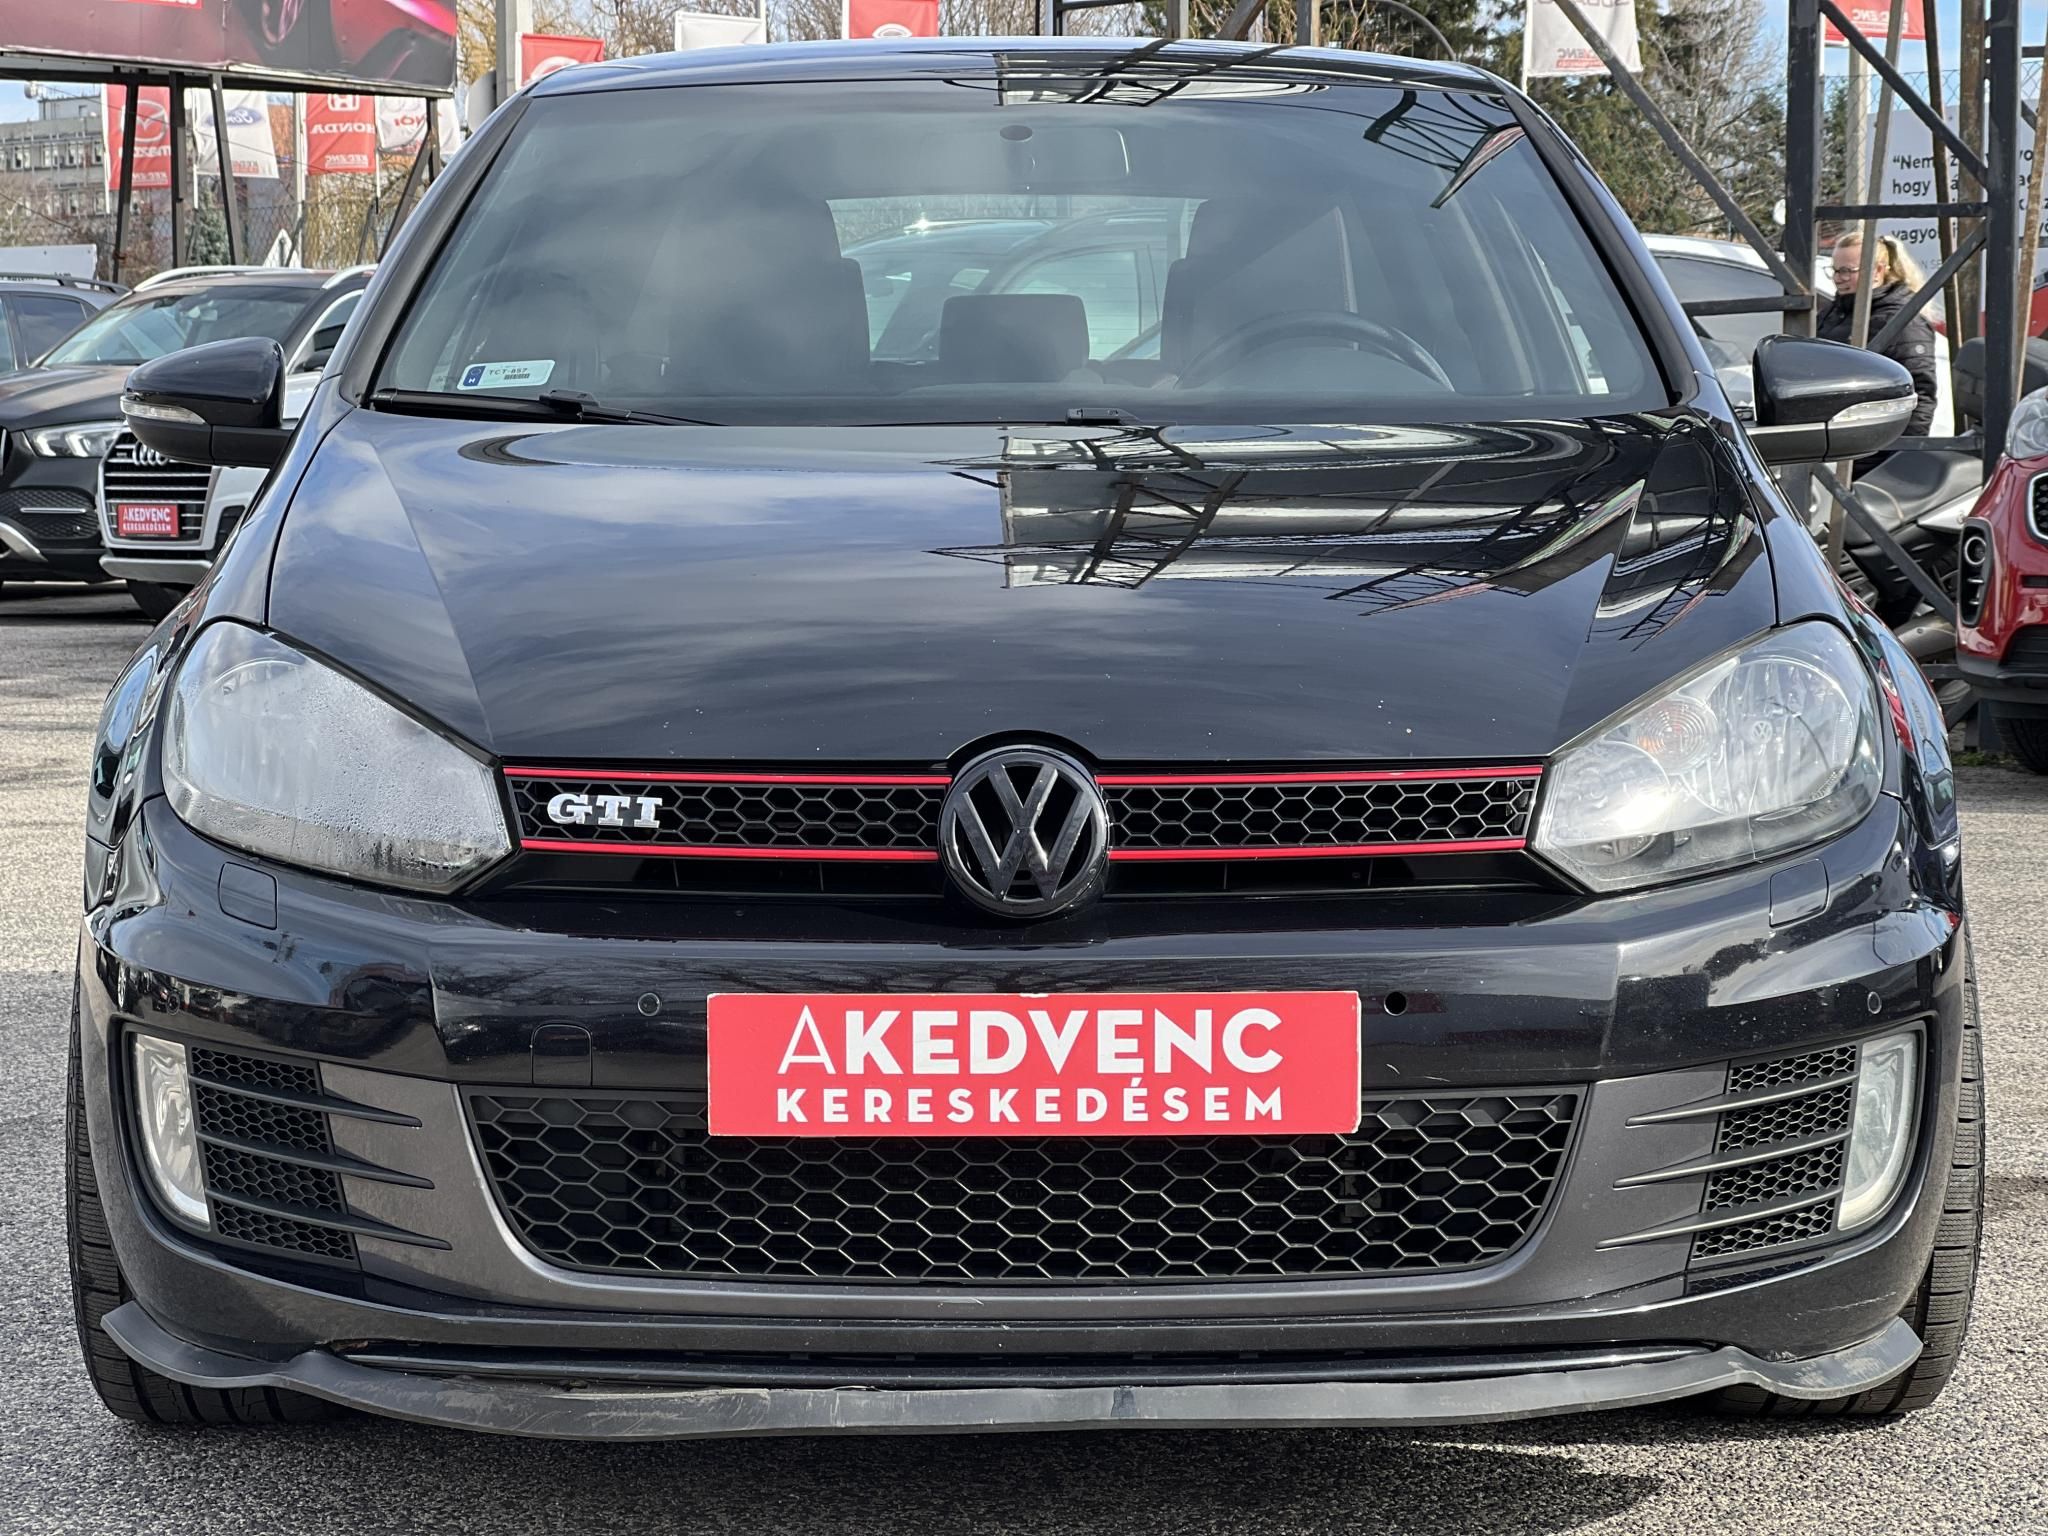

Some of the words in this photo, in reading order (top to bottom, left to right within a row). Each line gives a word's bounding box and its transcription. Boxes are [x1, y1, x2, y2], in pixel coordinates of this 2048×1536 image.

[1892, 179, 1931, 196] hogy
[1891, 227, 1937, 244] vagyo
[547, 792, 663, 829] GTI
[777, 1078, 1283, 1123] KERESKEDÉSEM
